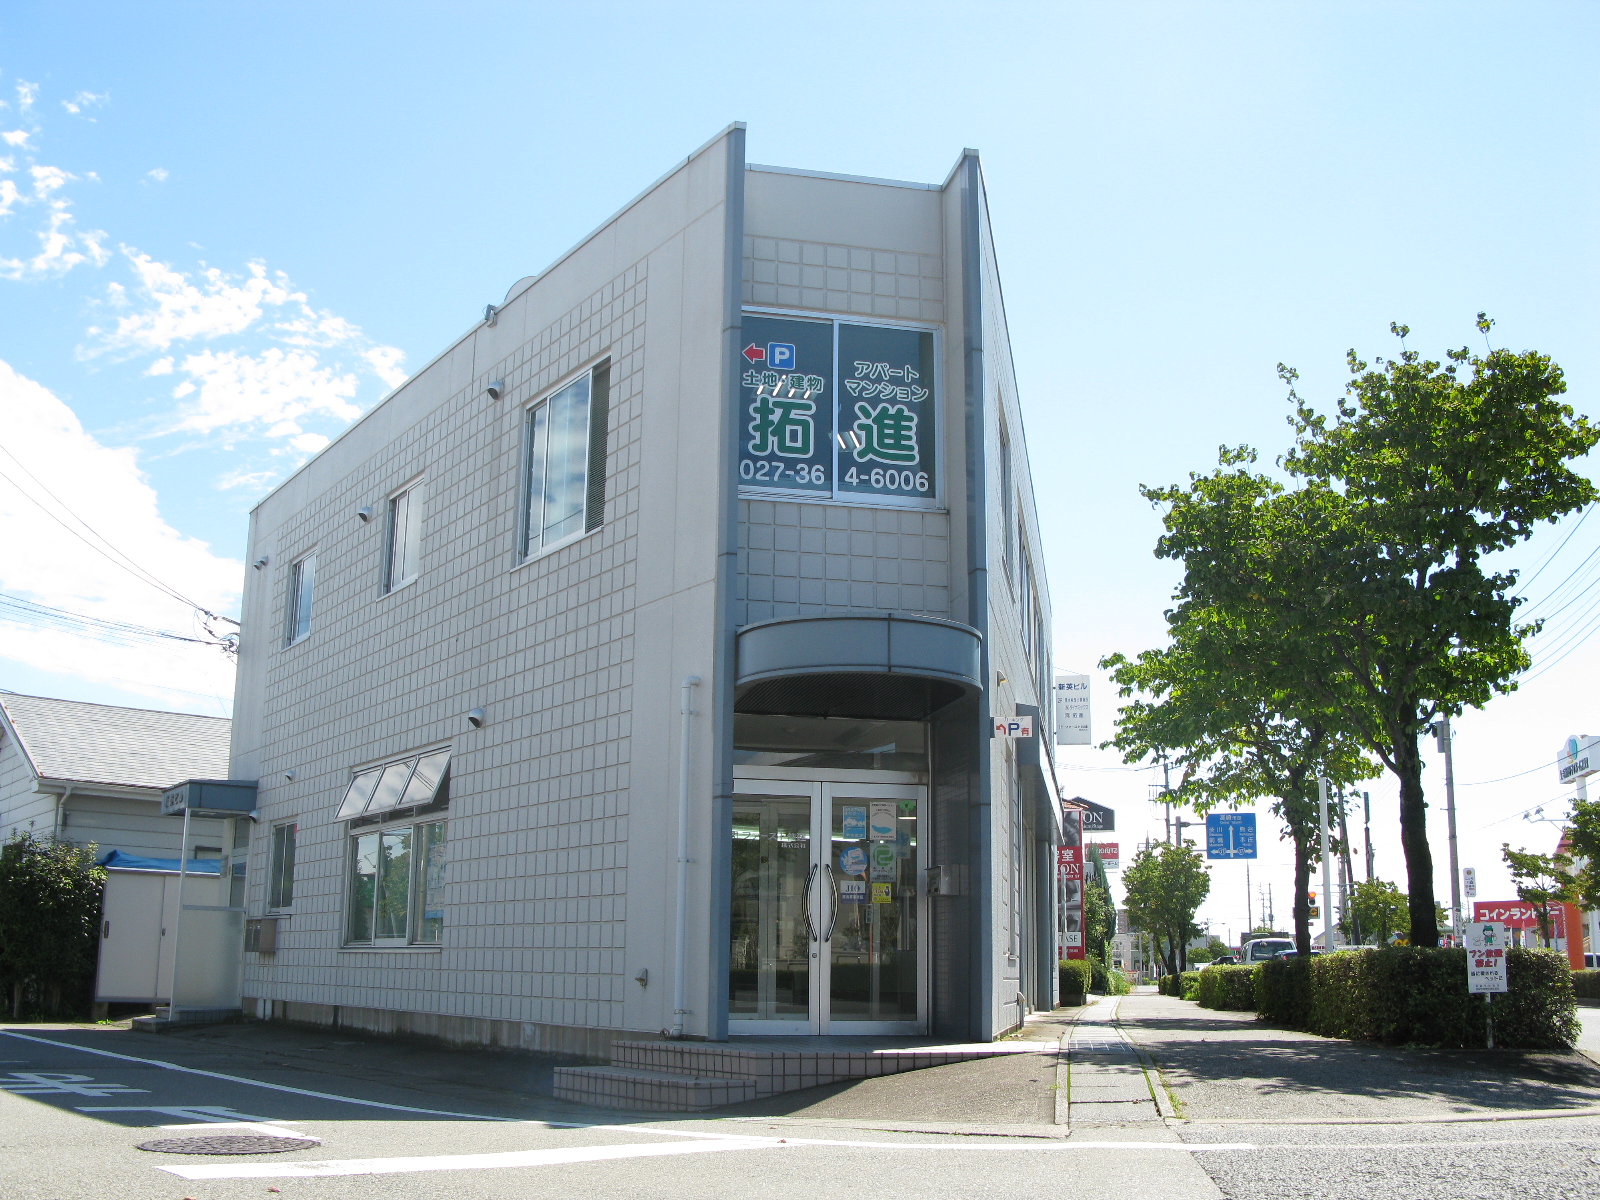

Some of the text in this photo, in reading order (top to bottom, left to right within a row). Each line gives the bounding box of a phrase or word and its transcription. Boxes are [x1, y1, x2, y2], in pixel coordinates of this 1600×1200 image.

[774, 347, 790, 364] P
[854, 361, 920, 382] アパート
[845, 379, 929, 402] マンション
[1058, 683, 1087, 691] 新英ビル
[1008, 723, 1030, 736] P 有
